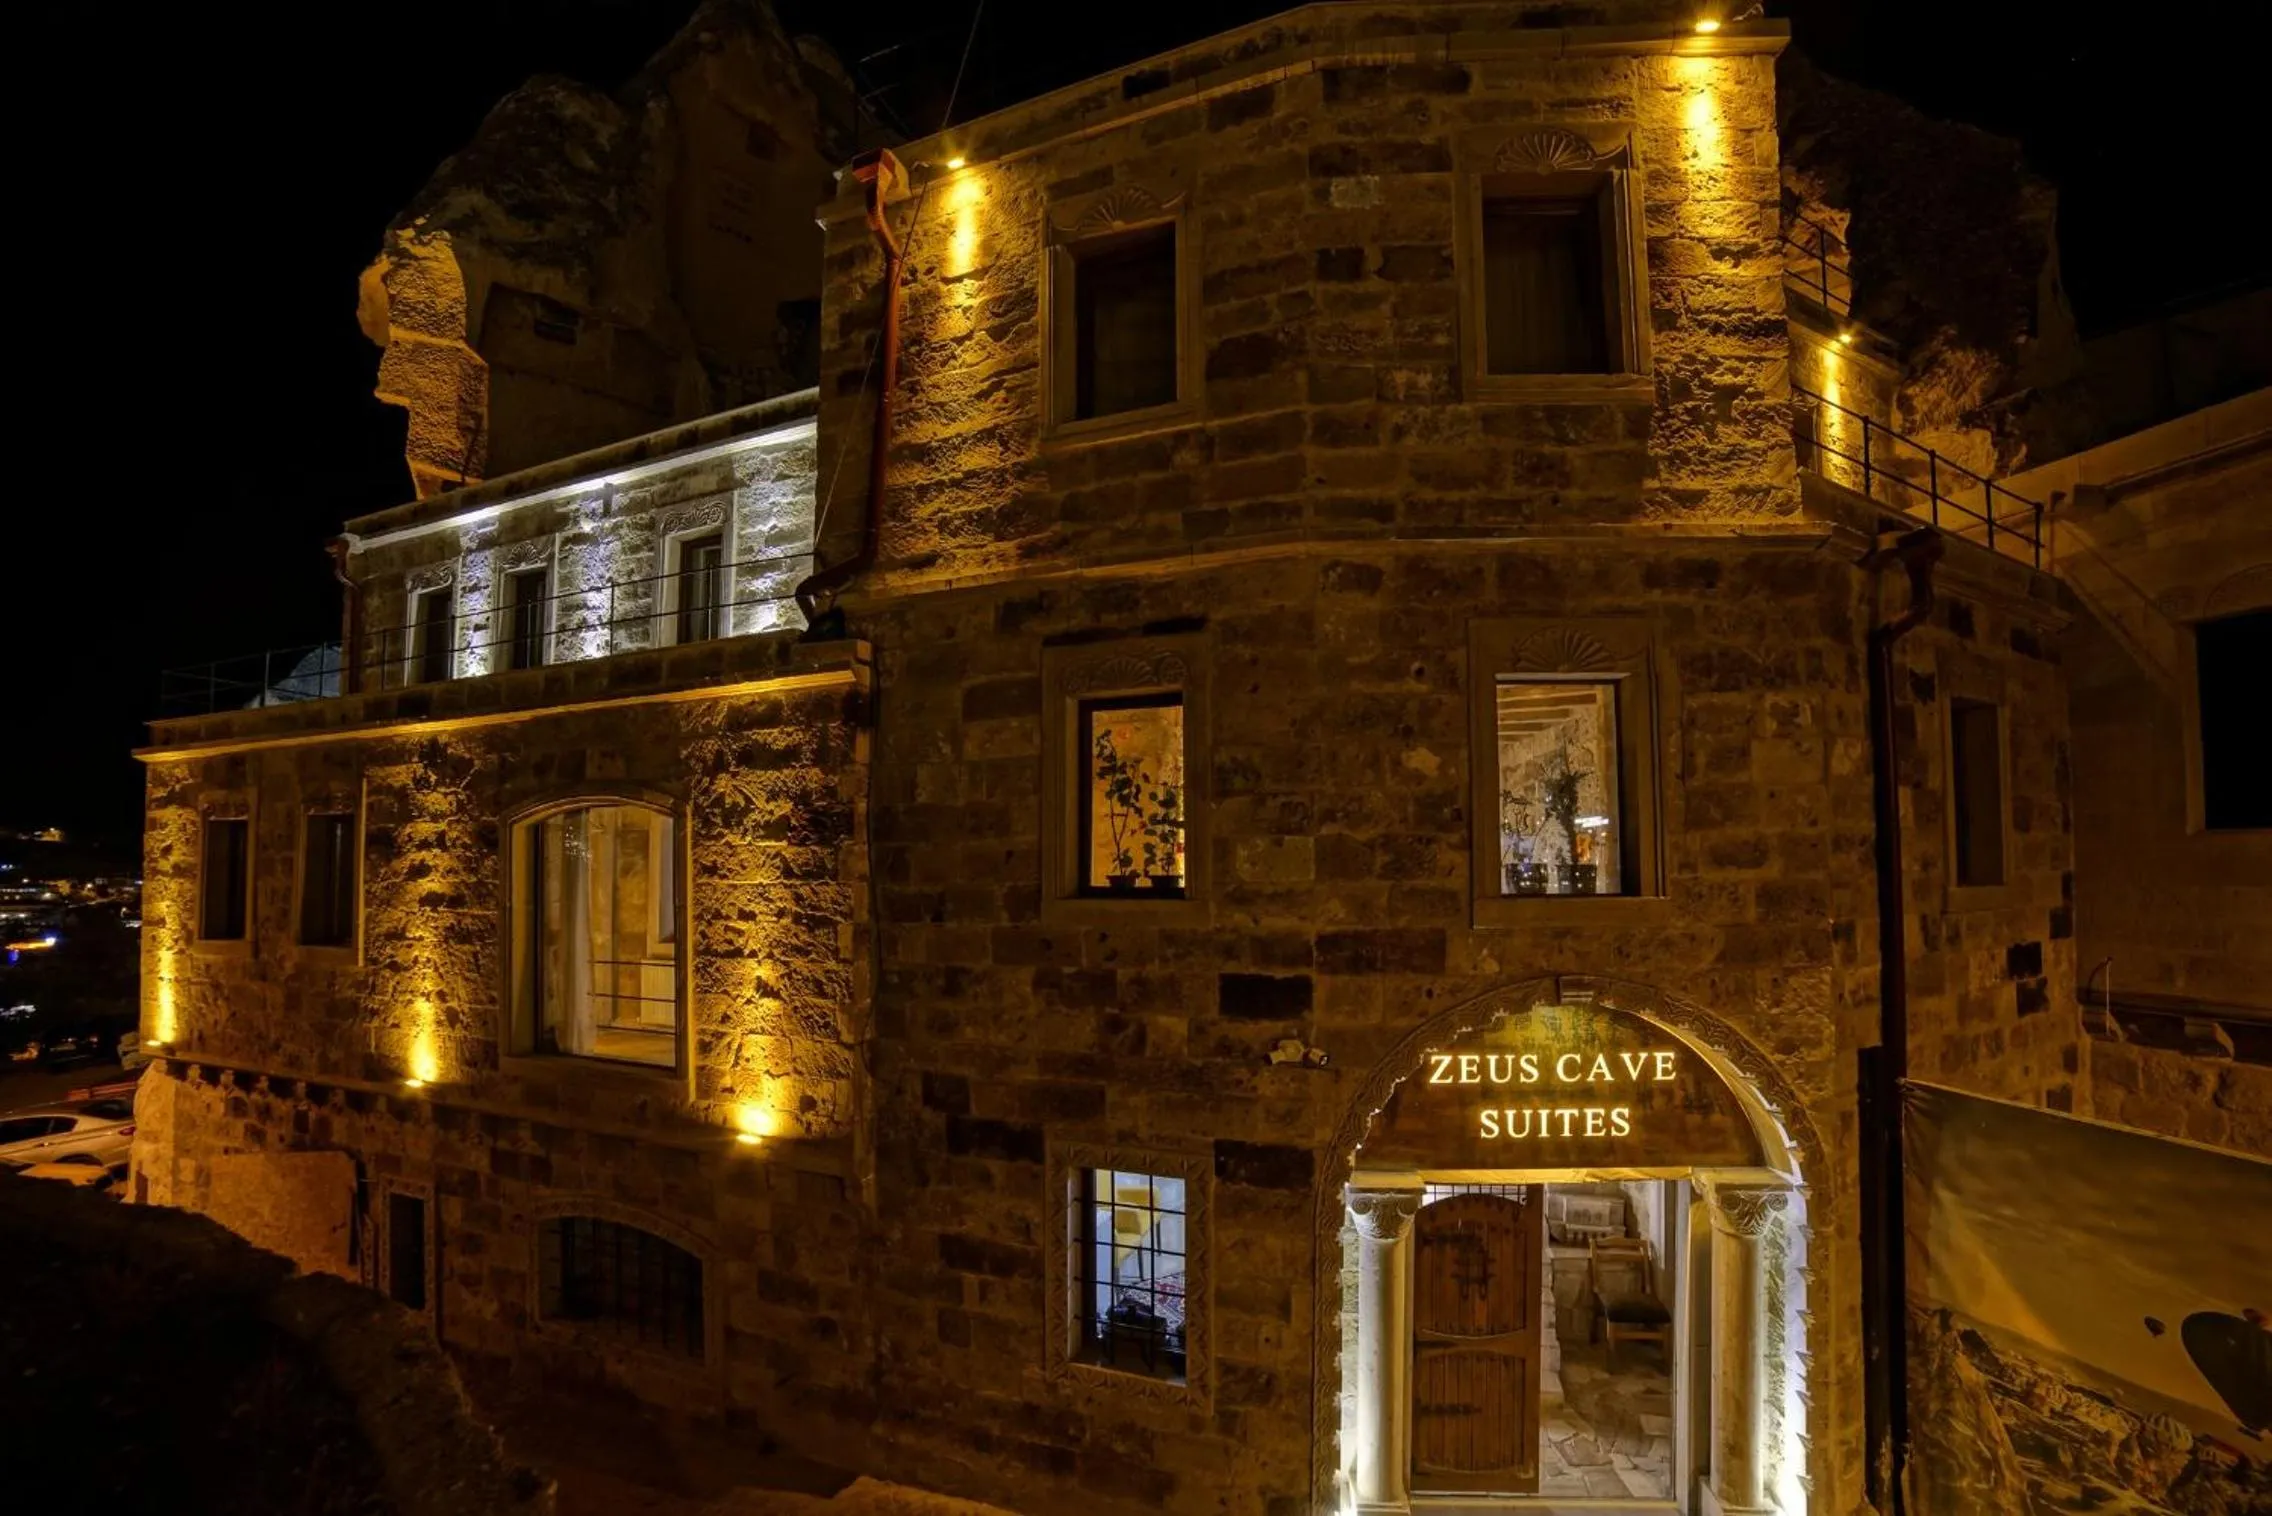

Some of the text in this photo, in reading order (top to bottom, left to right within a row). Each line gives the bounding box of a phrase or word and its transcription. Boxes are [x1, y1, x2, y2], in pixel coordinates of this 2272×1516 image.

[1430, 1052, 1677, 1084] ZEUS CAVE
[1480, 1107, 1631, 1139] SUITES
